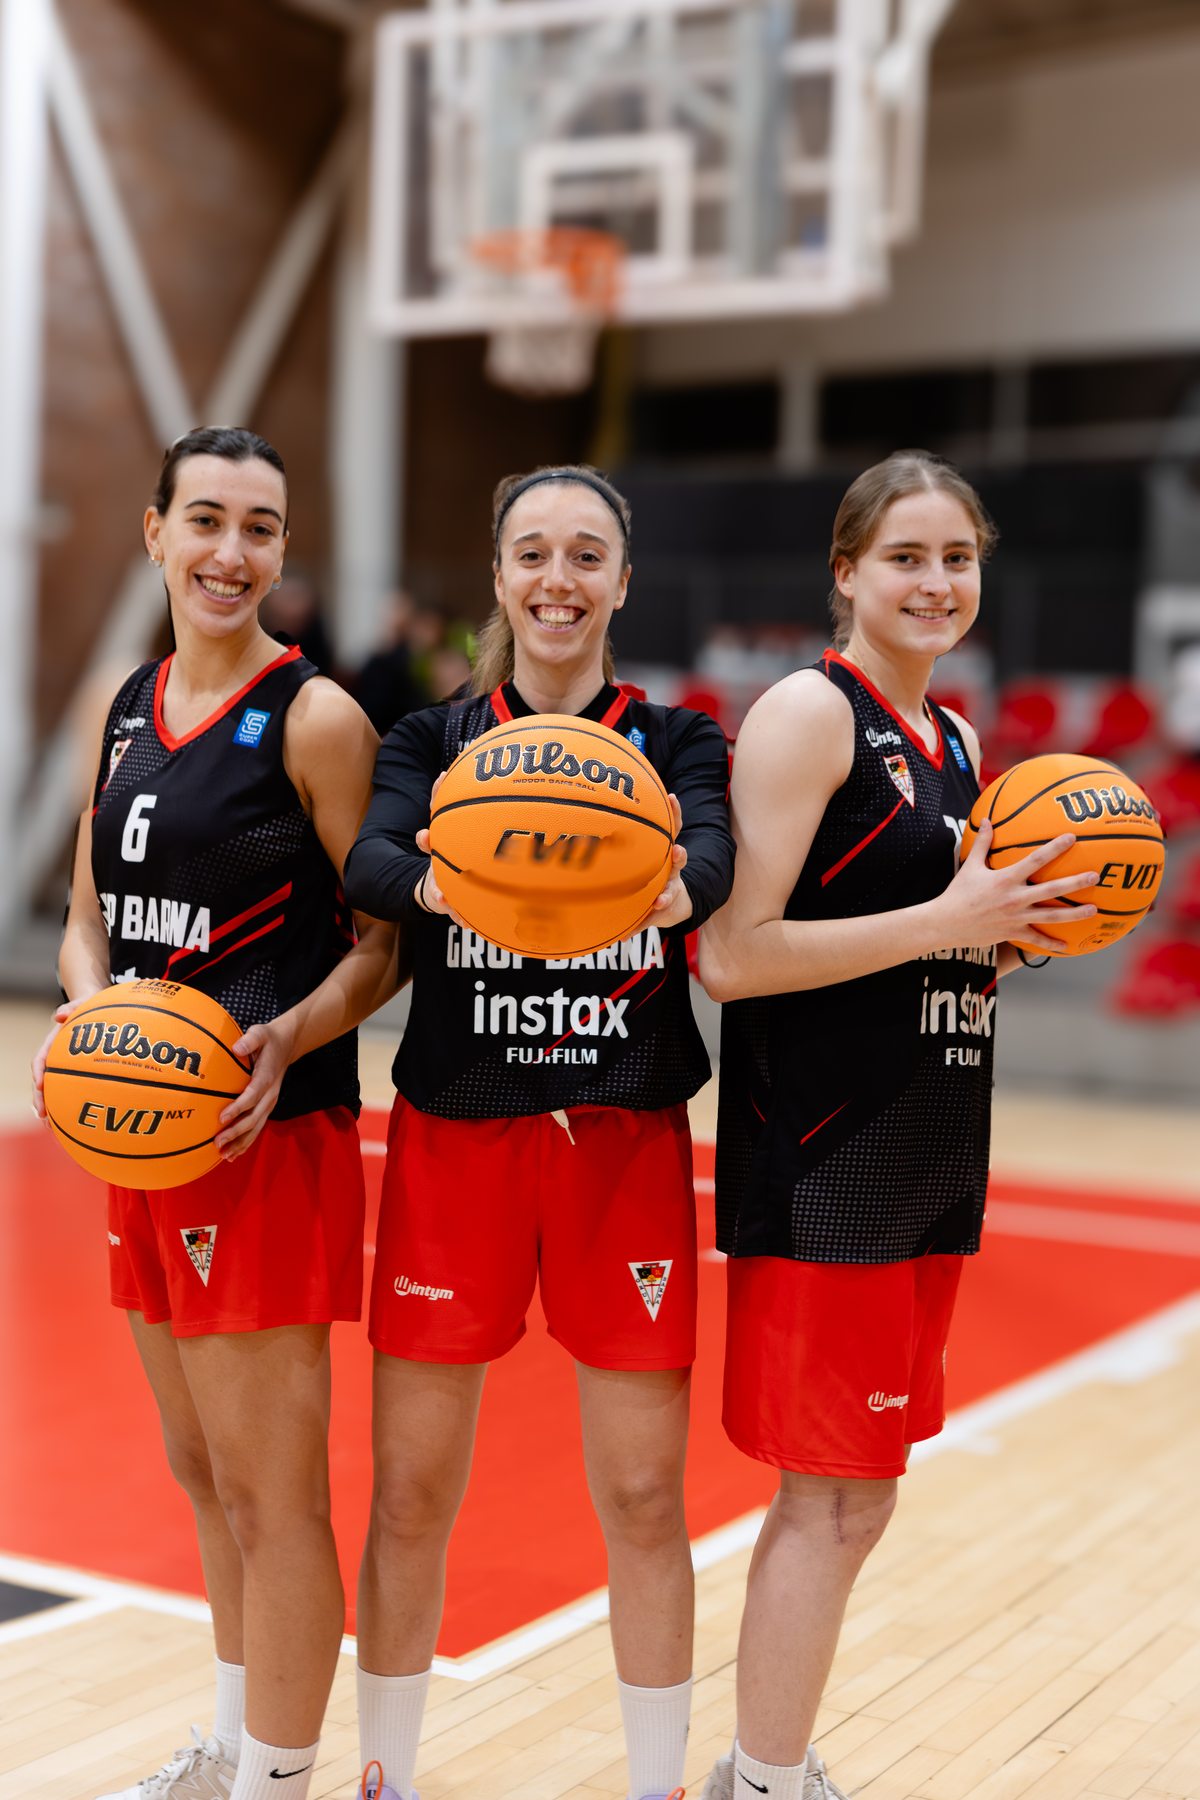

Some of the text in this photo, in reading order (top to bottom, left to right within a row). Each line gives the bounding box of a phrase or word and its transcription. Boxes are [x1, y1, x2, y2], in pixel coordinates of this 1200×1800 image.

[475, 741, 636, 801] Wilson
[121, 794, 157, 862] 6
[1096, 862, 1159, 890] EVO
[473, 980, 630, 1039] instax
[69, 1022, 202, 1077] Wilson
[506, 1047, 598, 1065] FUJIFILM
[78, 1101, 195, 1135] EVO NXT
